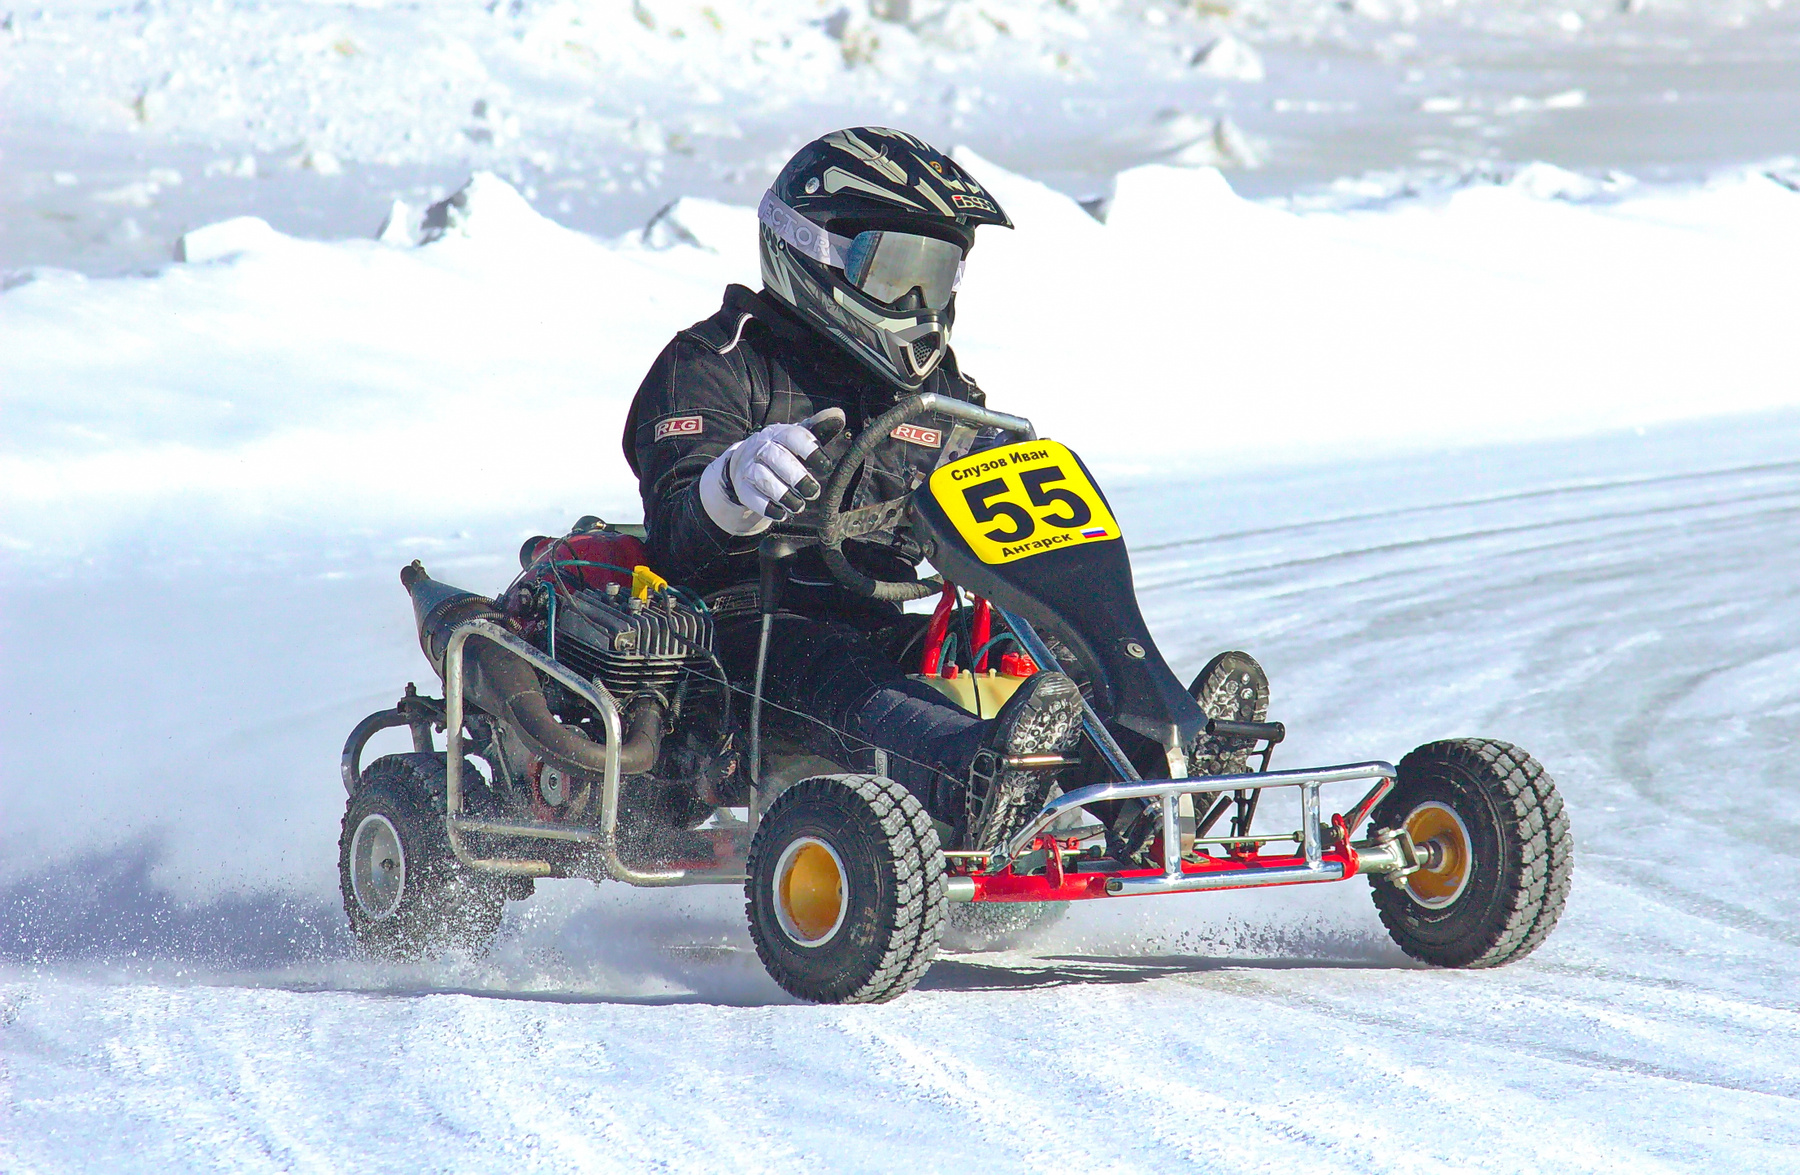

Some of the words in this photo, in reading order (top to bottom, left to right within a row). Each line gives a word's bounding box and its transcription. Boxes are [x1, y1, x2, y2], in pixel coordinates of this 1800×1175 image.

[657, 420, 697, 437] RLG
[896, 426, 936, 443] RLG
[951, 458, 1008, 481] Слузов
[1009, 449, 1049, 464] Иван
[961, 465, 1092, 544] 55
[1002, 532, 1073, 558] Ангарск
